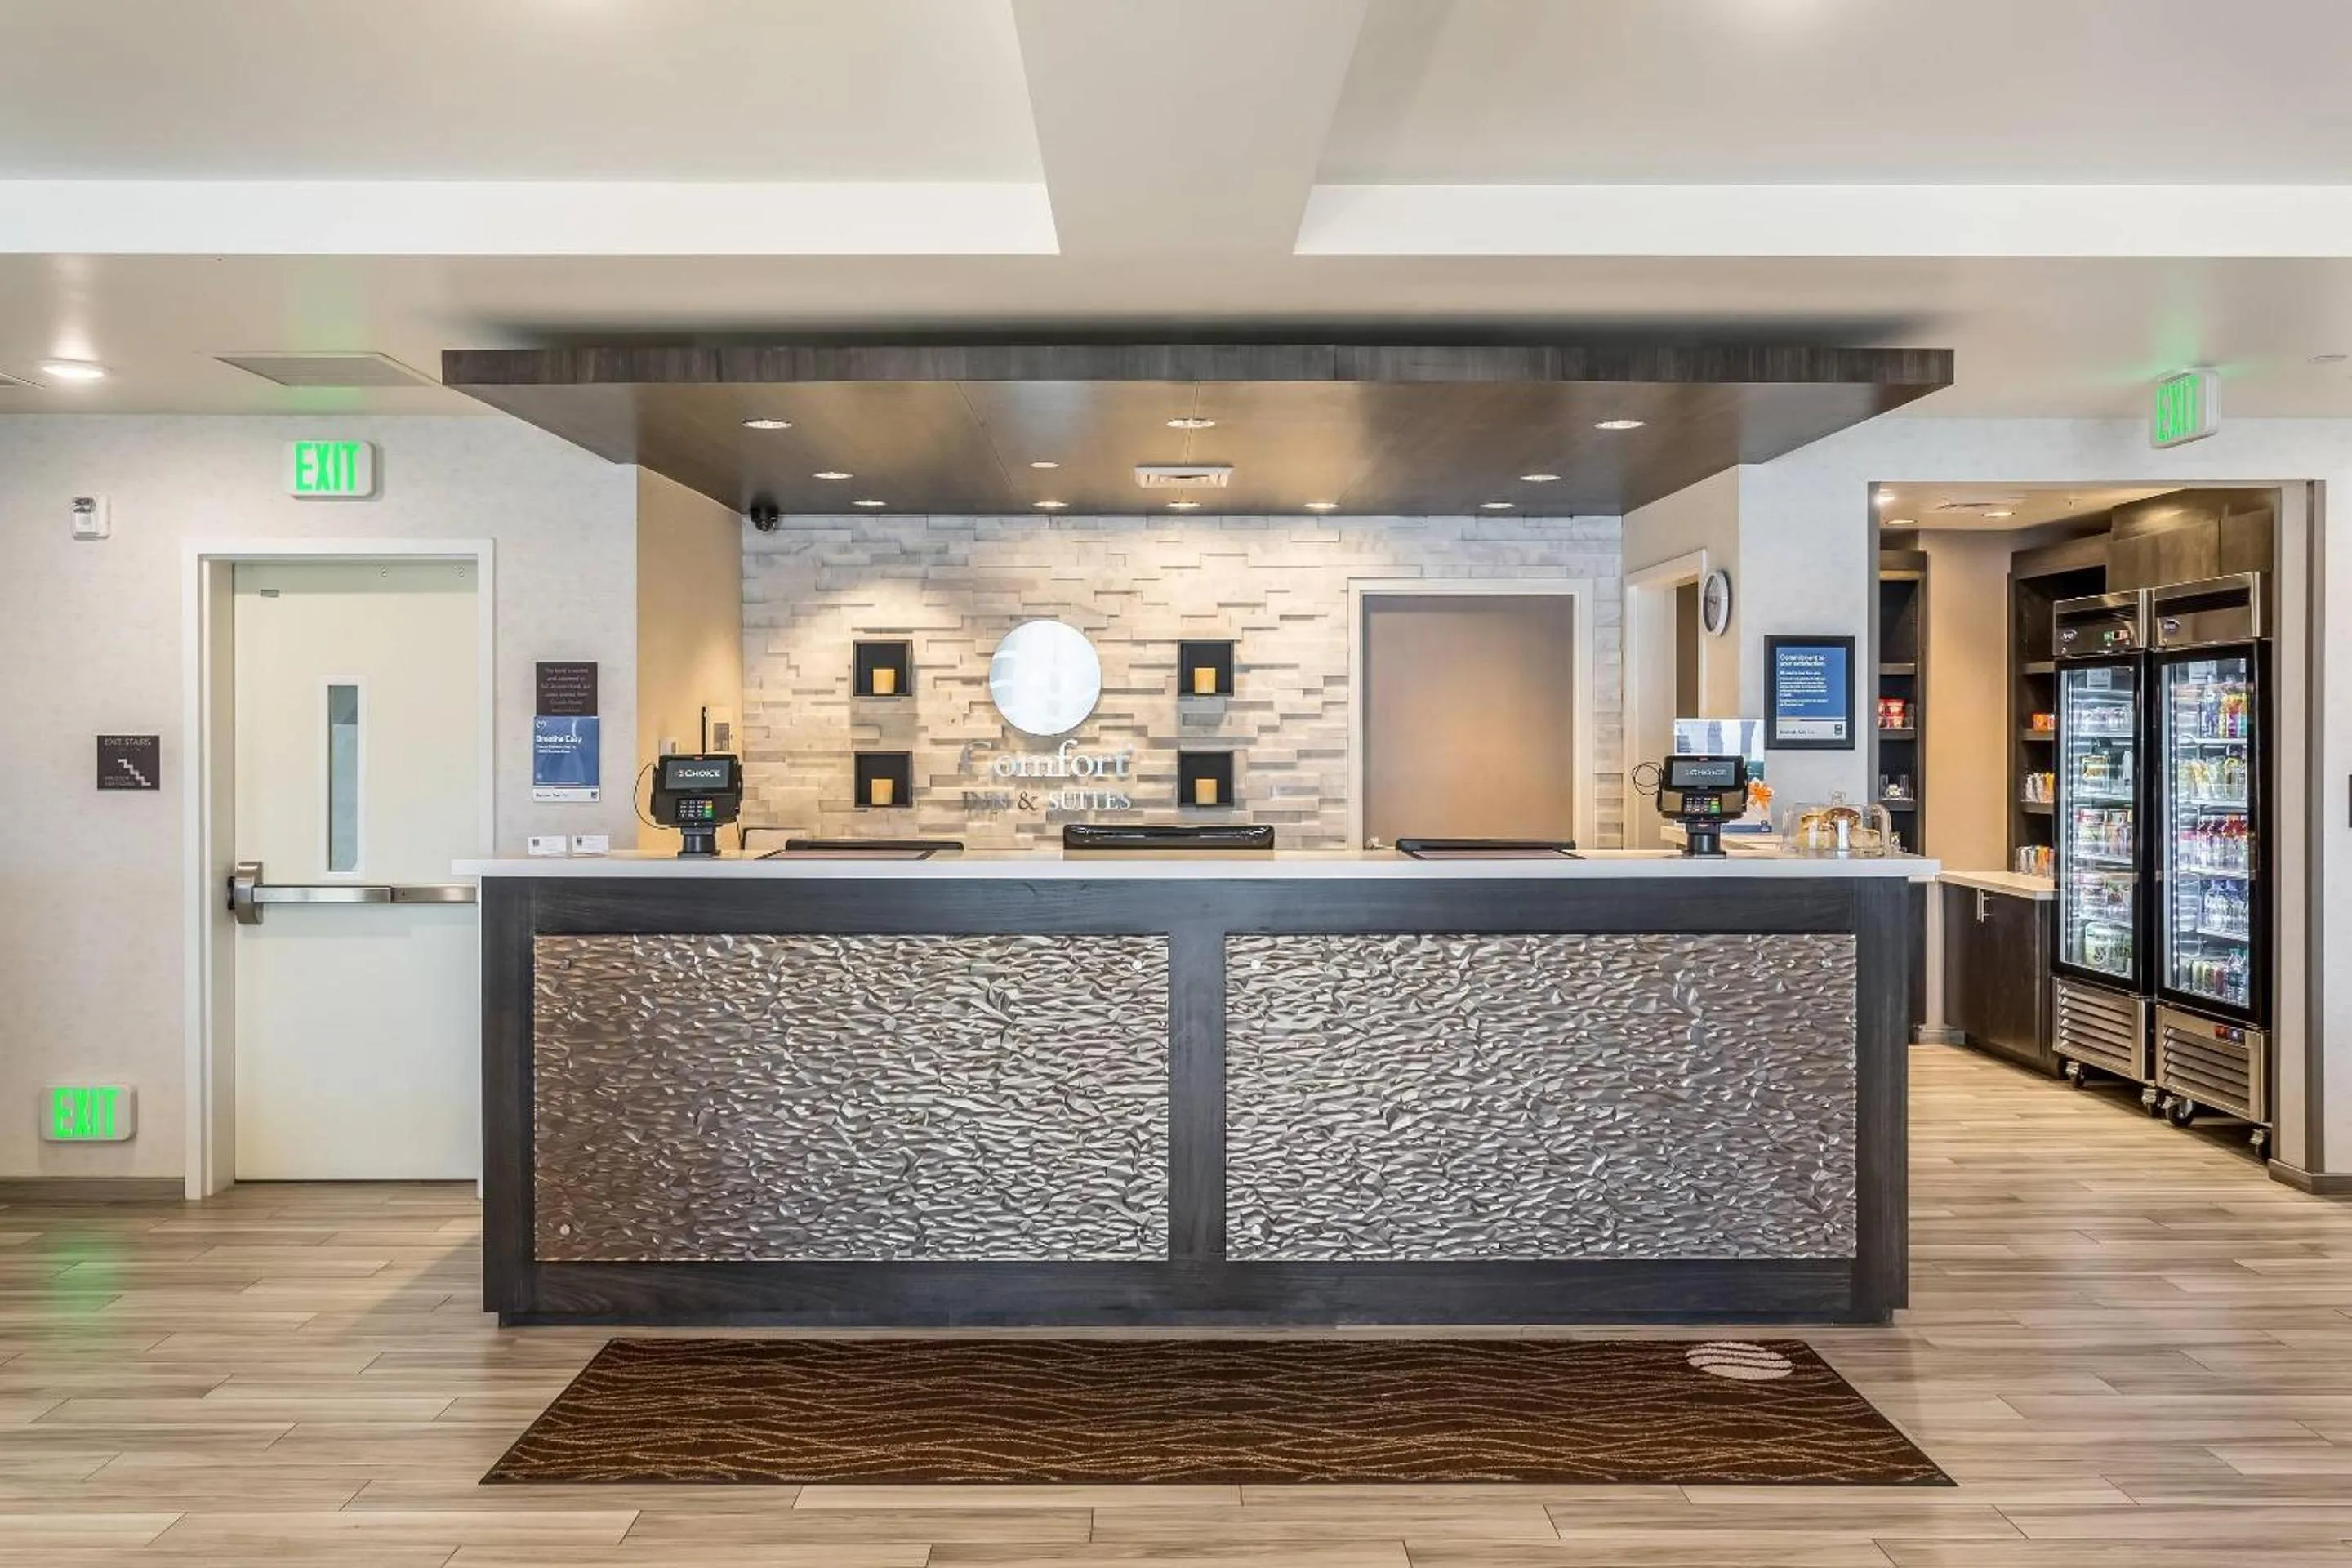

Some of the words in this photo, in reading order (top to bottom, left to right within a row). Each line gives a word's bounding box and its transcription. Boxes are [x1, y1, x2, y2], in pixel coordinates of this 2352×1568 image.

[2157, 375, 2200, 441] EXIT
[295, 440, 360, 492] EXIT
[105, 737, 122, 746] EXIT
[124, 737, 152, 746] STAIRS
[535, 734, 564, 742] Breathe
[959, 739, 1129, 777] Comfort
[1017, 791, 1039, 811] &
[1048, 790, 1131, 810] SUITES
[52, 1086, 121, 1138] EXIT
